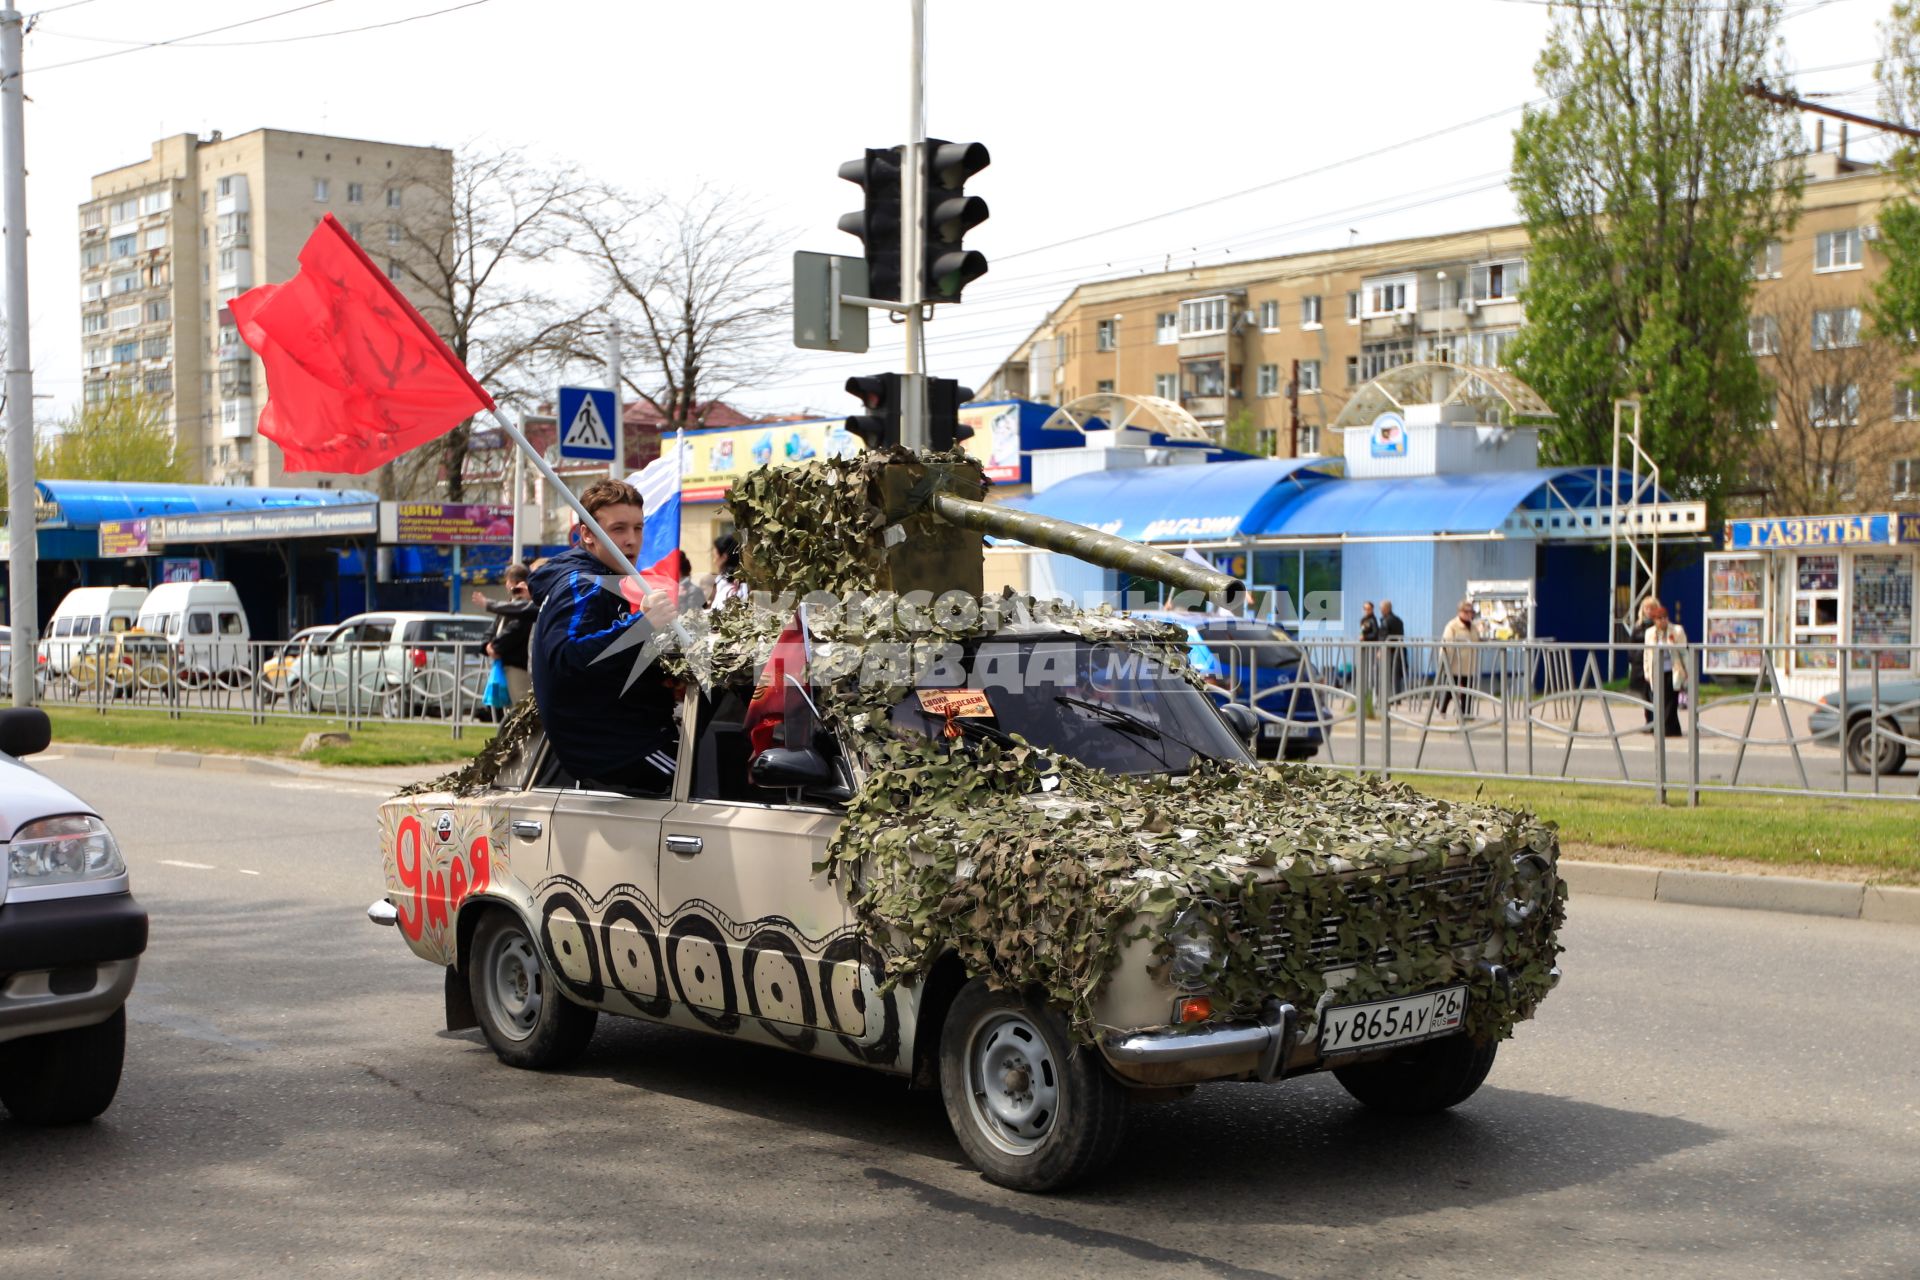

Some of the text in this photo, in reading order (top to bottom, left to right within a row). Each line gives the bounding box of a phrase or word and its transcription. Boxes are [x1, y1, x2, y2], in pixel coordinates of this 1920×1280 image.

[399, 504, 443, 517] ЦВЕТЫ
[1749, 518, 1873, 547] ГАЗЕТЫ
[922, 695, 949, 708] СВОИХ
[397, 817, 423, 939] 9
[1431, 1016, 1448, 1028] RUS
